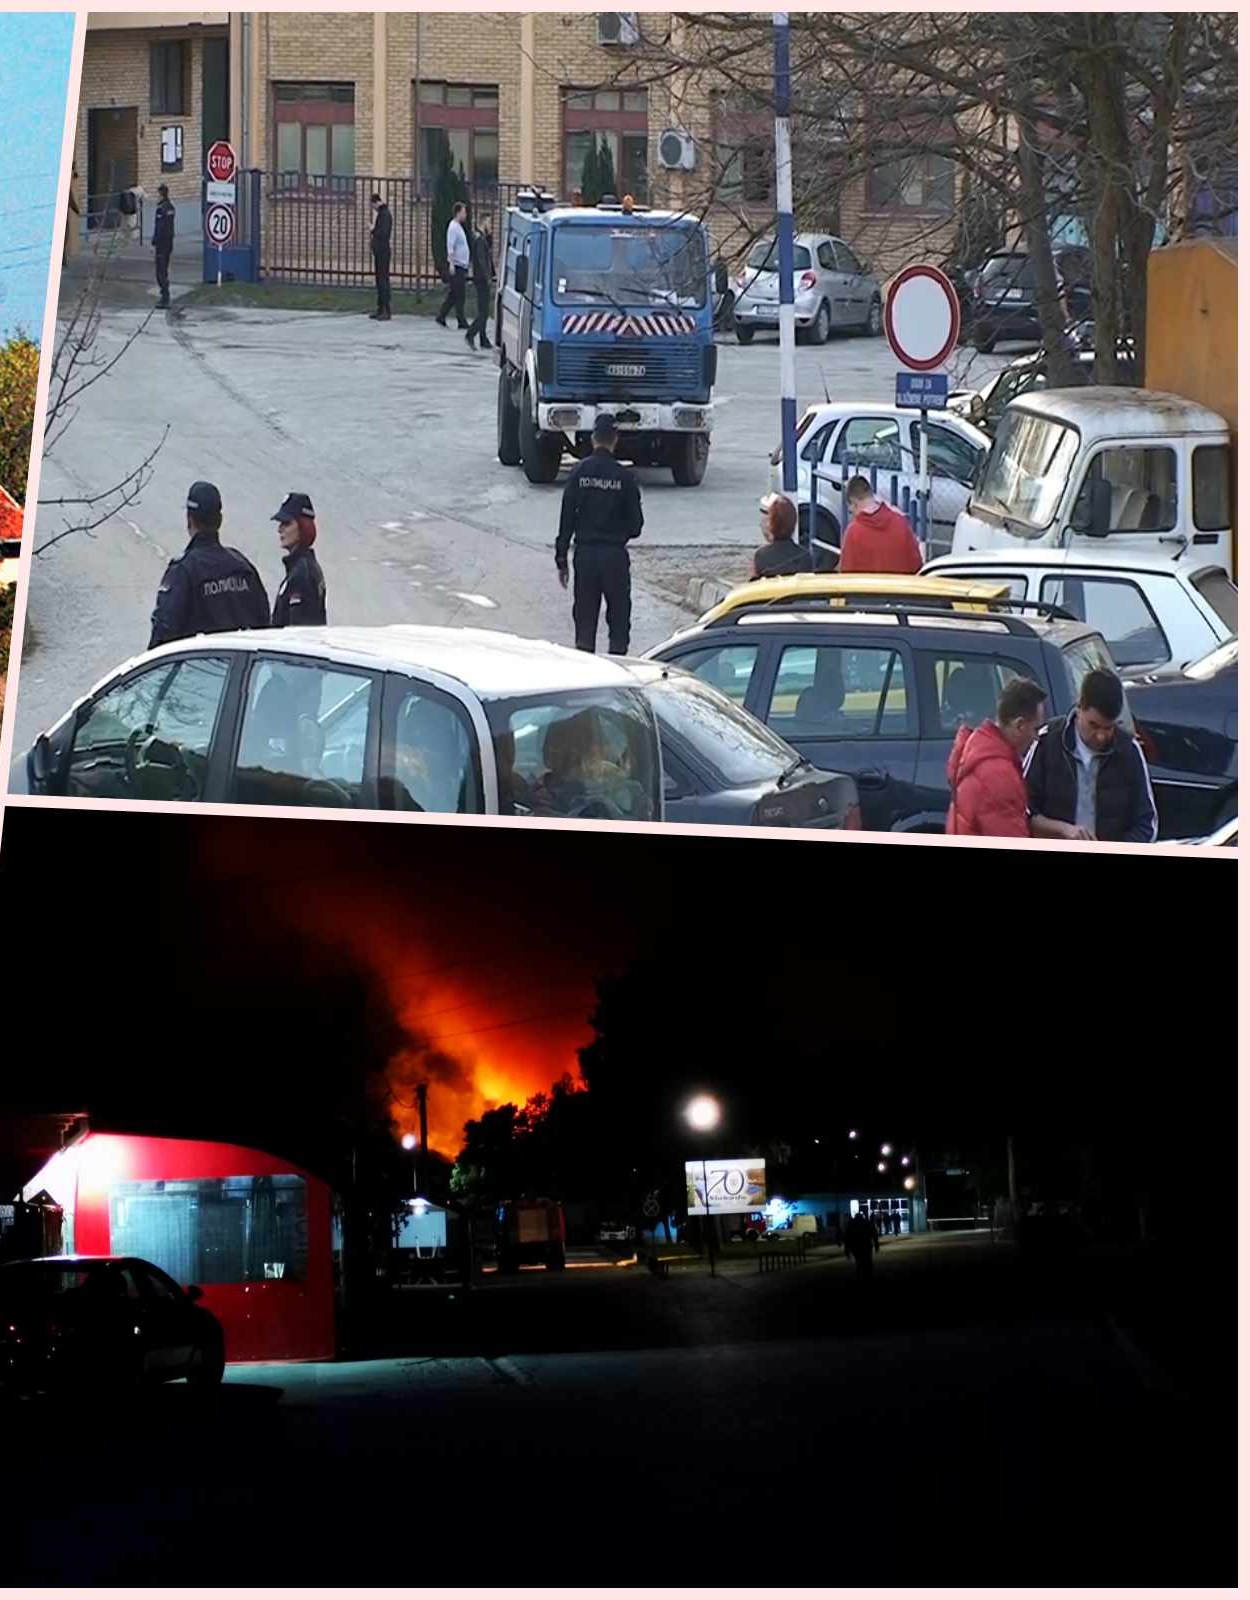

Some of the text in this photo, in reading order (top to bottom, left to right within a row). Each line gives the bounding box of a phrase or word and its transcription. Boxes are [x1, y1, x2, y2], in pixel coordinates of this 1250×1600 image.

[211, 155, 232, 169] STOP
[213, 214, 228, 234] 20
[707, 1169, 745, 1197] 70
